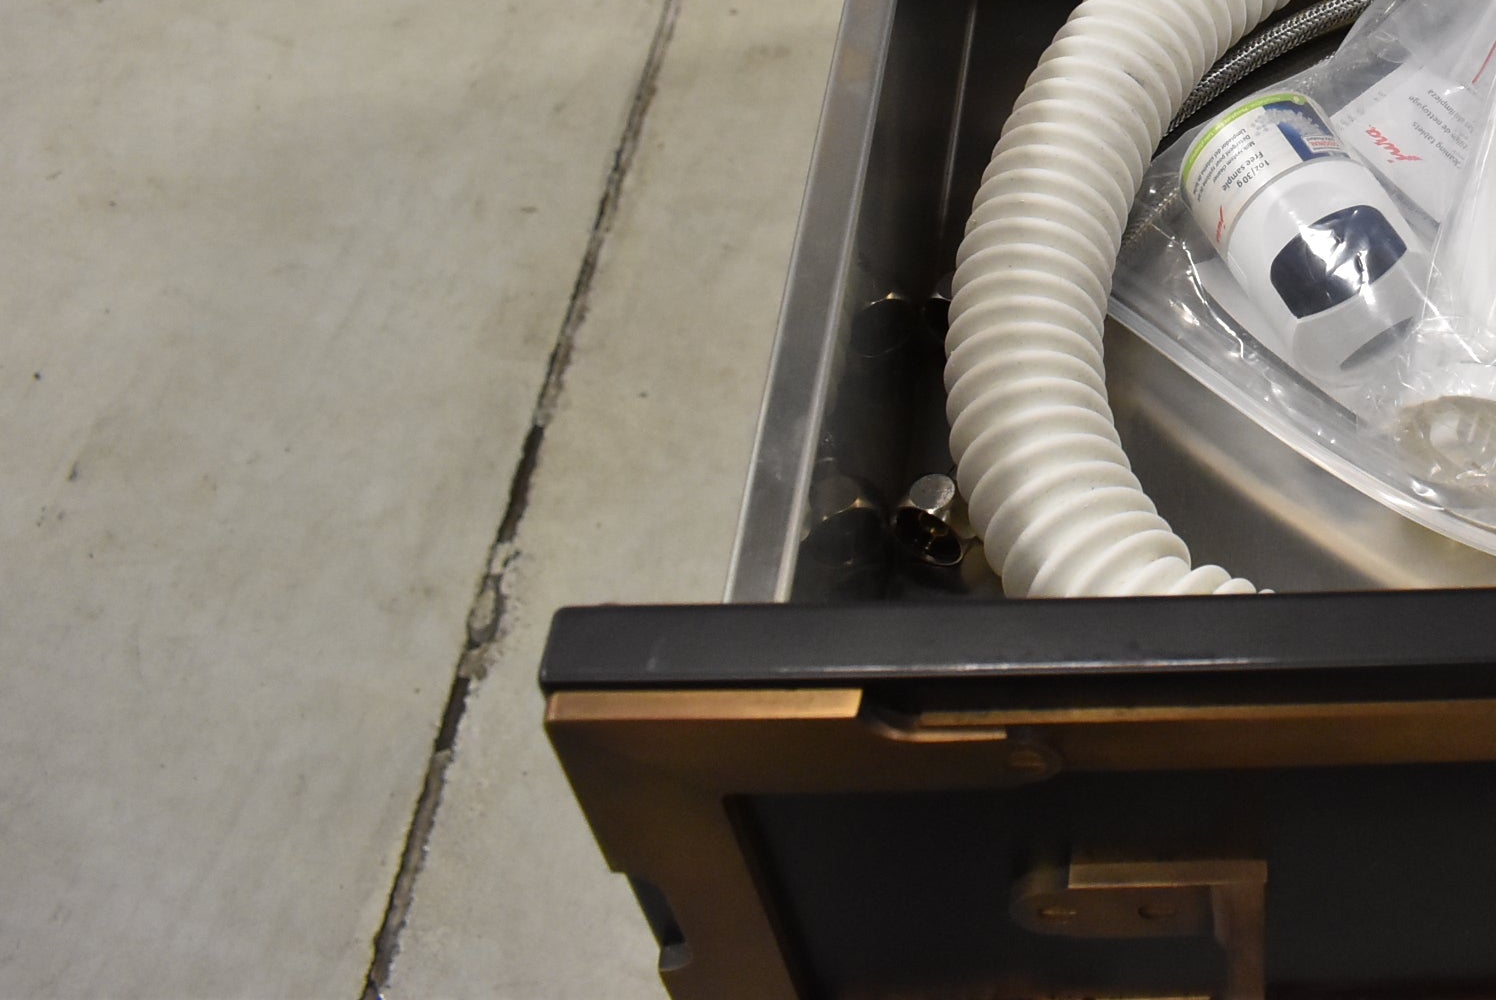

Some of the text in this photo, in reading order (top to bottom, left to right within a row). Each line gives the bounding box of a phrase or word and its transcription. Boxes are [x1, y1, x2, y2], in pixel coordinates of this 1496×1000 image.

[1408, 95, 1441, 124] nettoyage
[1427, 89, 1455, 114] limpieza
[1366, 125, 1422, 163] jura
[1411, 121, 1435, 143] tablets
[1434, 142, 1461, 168] leaning
[1220, 151, 1263, 192] Free sample
